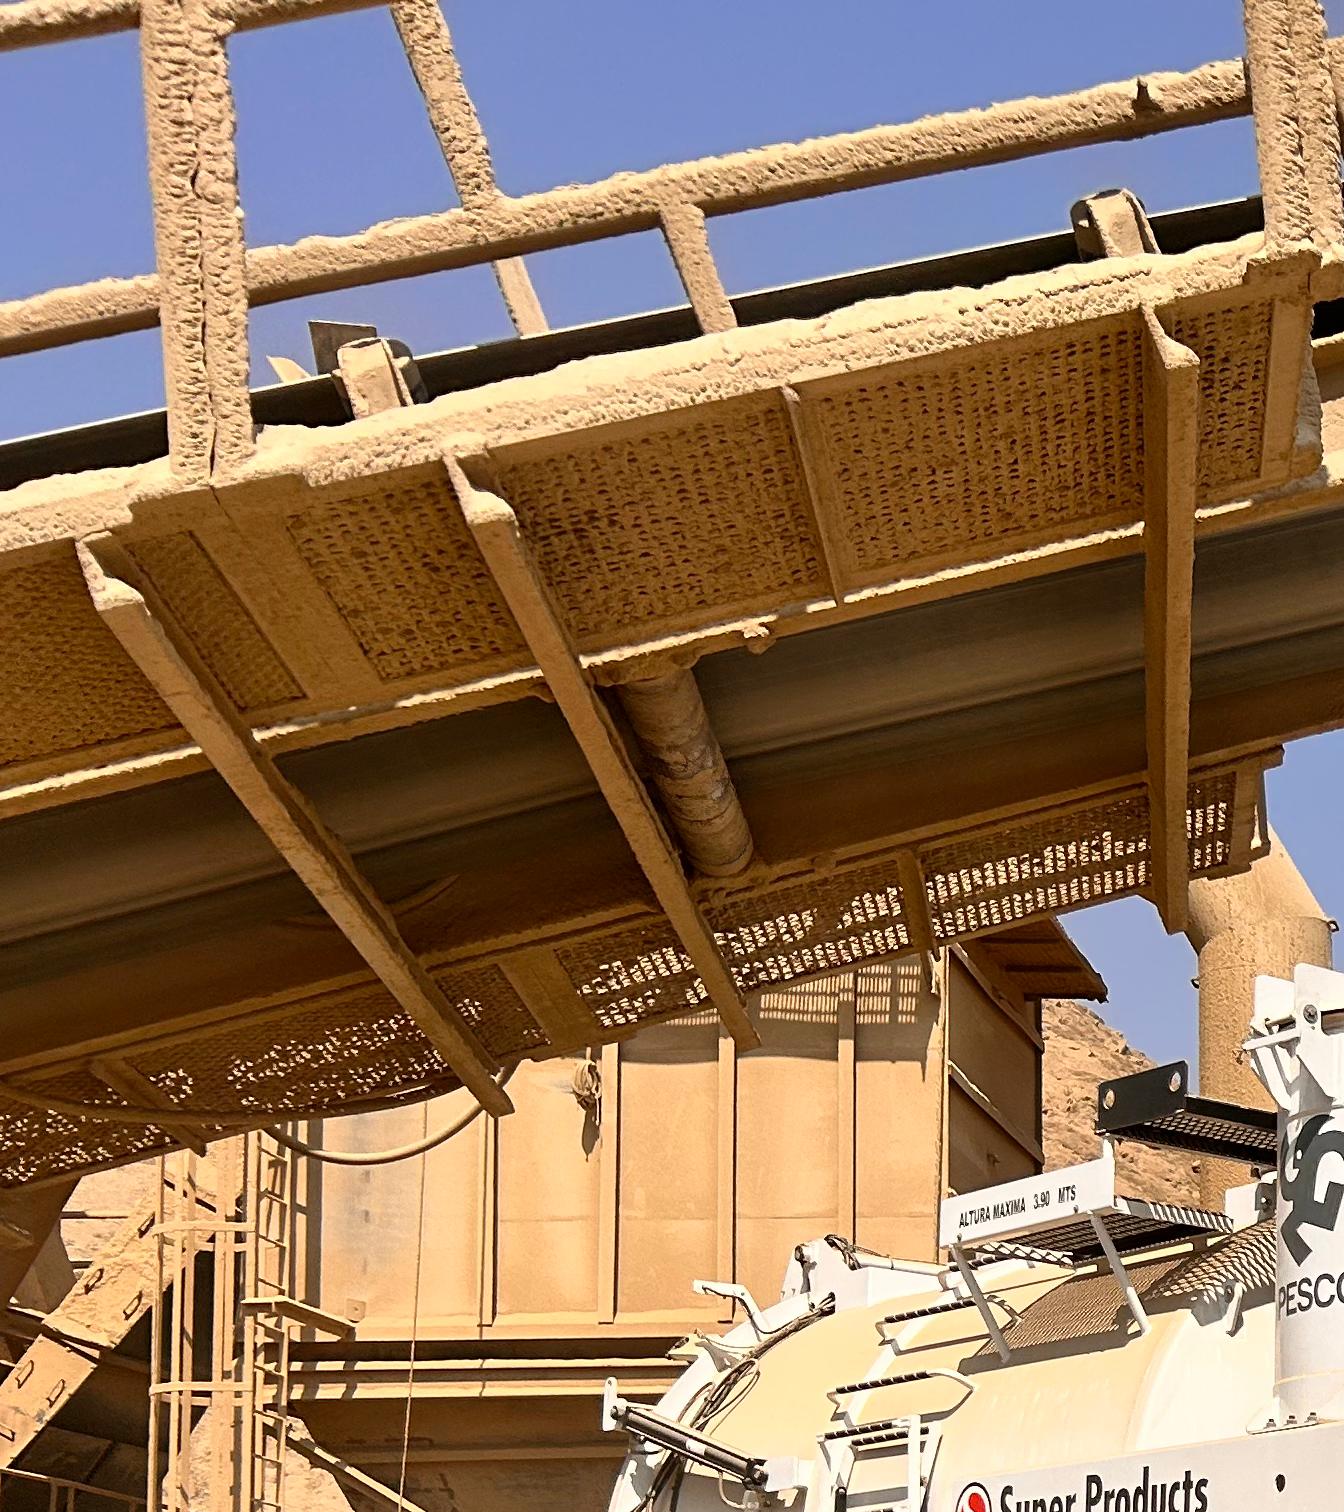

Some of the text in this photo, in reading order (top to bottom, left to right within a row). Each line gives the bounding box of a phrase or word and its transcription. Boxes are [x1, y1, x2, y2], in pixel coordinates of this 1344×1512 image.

[959, 1184, 1077, 1228] ALTURA MAXIMA 3.90 MTS
